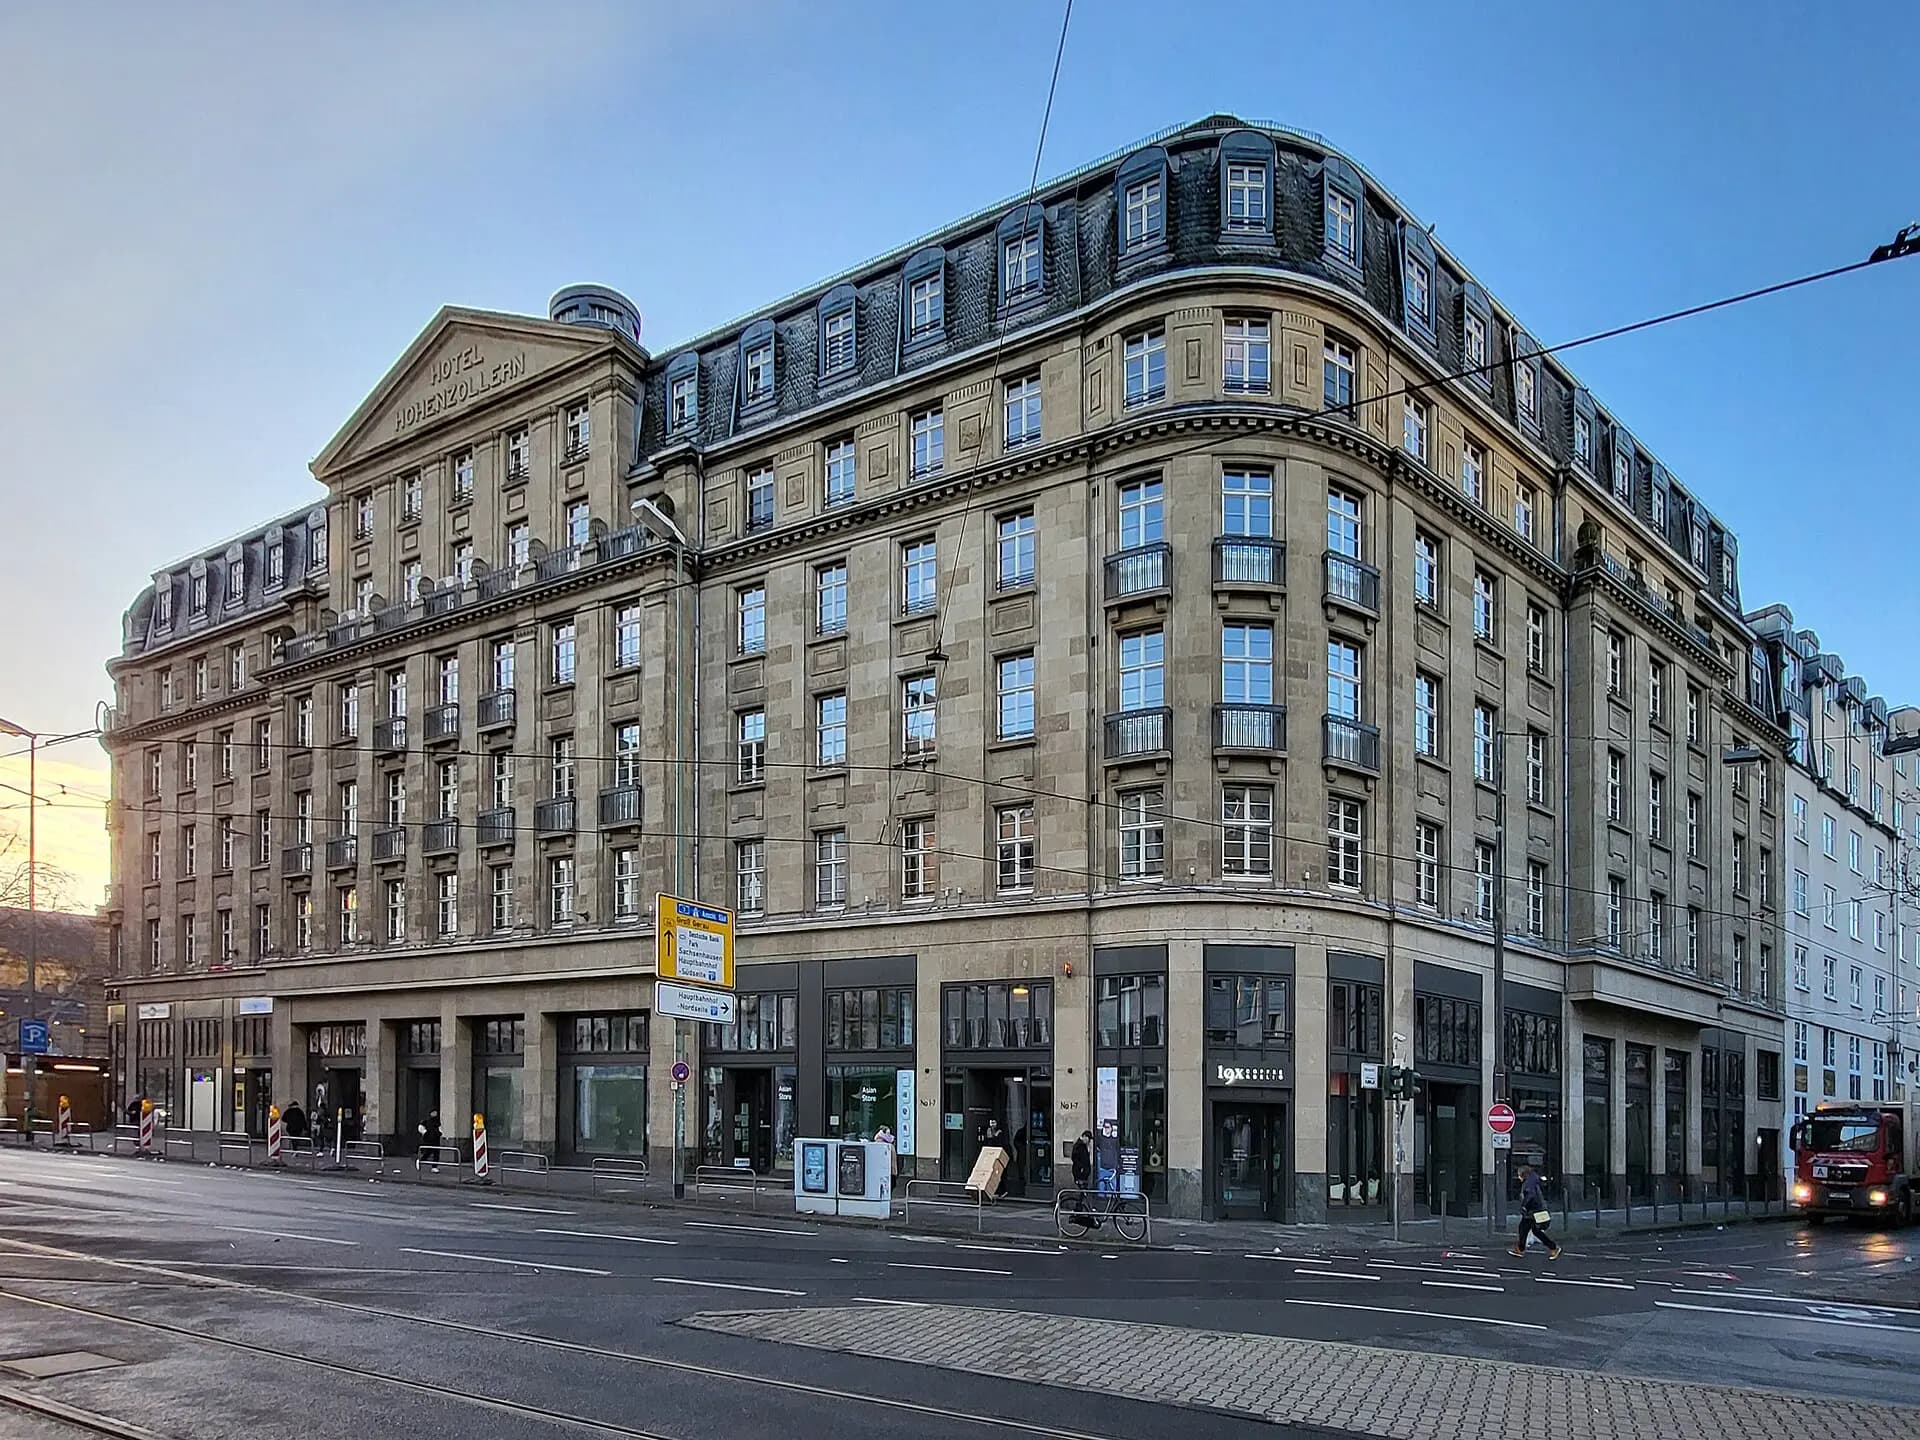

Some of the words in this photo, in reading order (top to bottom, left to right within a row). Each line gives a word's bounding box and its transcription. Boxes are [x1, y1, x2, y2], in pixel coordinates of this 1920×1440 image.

[430, 345, 484, 385] HOTEL
[395, 352, 526, 431] HOHENZOLLERN
[679, 946, 723, 960] Sachsenhausen
[678, 956, 718, 969] Hauptbahnhof
[678, 991, 719, 1003] Hauptbahnhof
[778, 1092, 792, 1100] Store
[861, 1094, 877, 1102] Store
